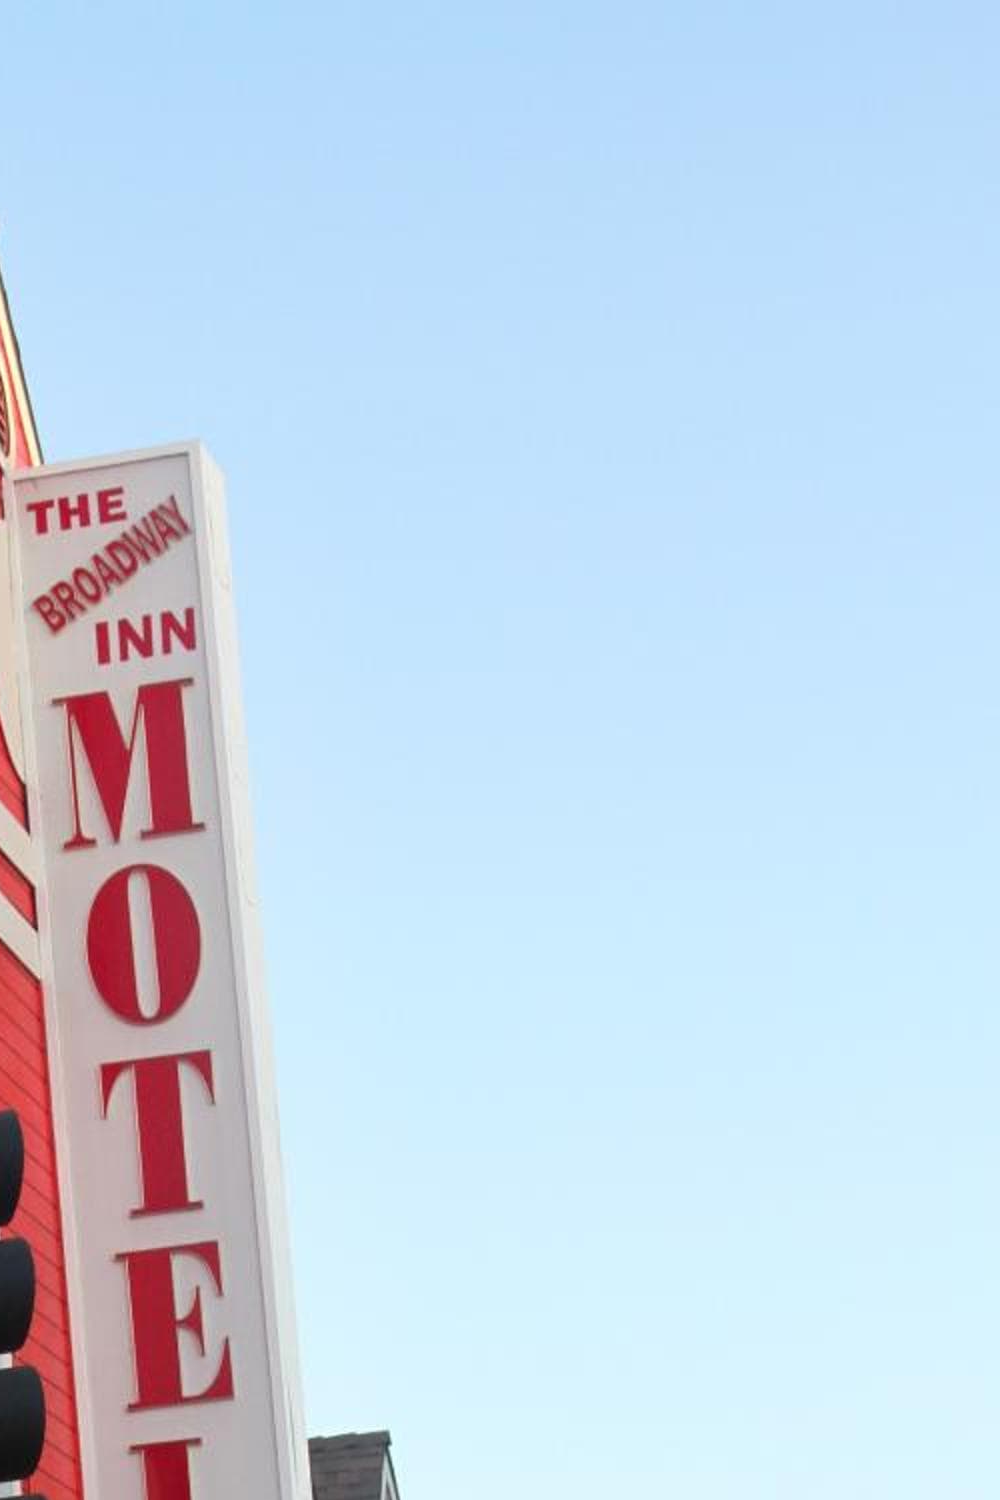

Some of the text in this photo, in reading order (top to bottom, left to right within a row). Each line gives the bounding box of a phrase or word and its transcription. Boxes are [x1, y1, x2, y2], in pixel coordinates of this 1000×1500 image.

[26, 486, 128, 534] THE
[31, 493, 192, 635] BROADWAY
[96, 607, 197, 665] INN
